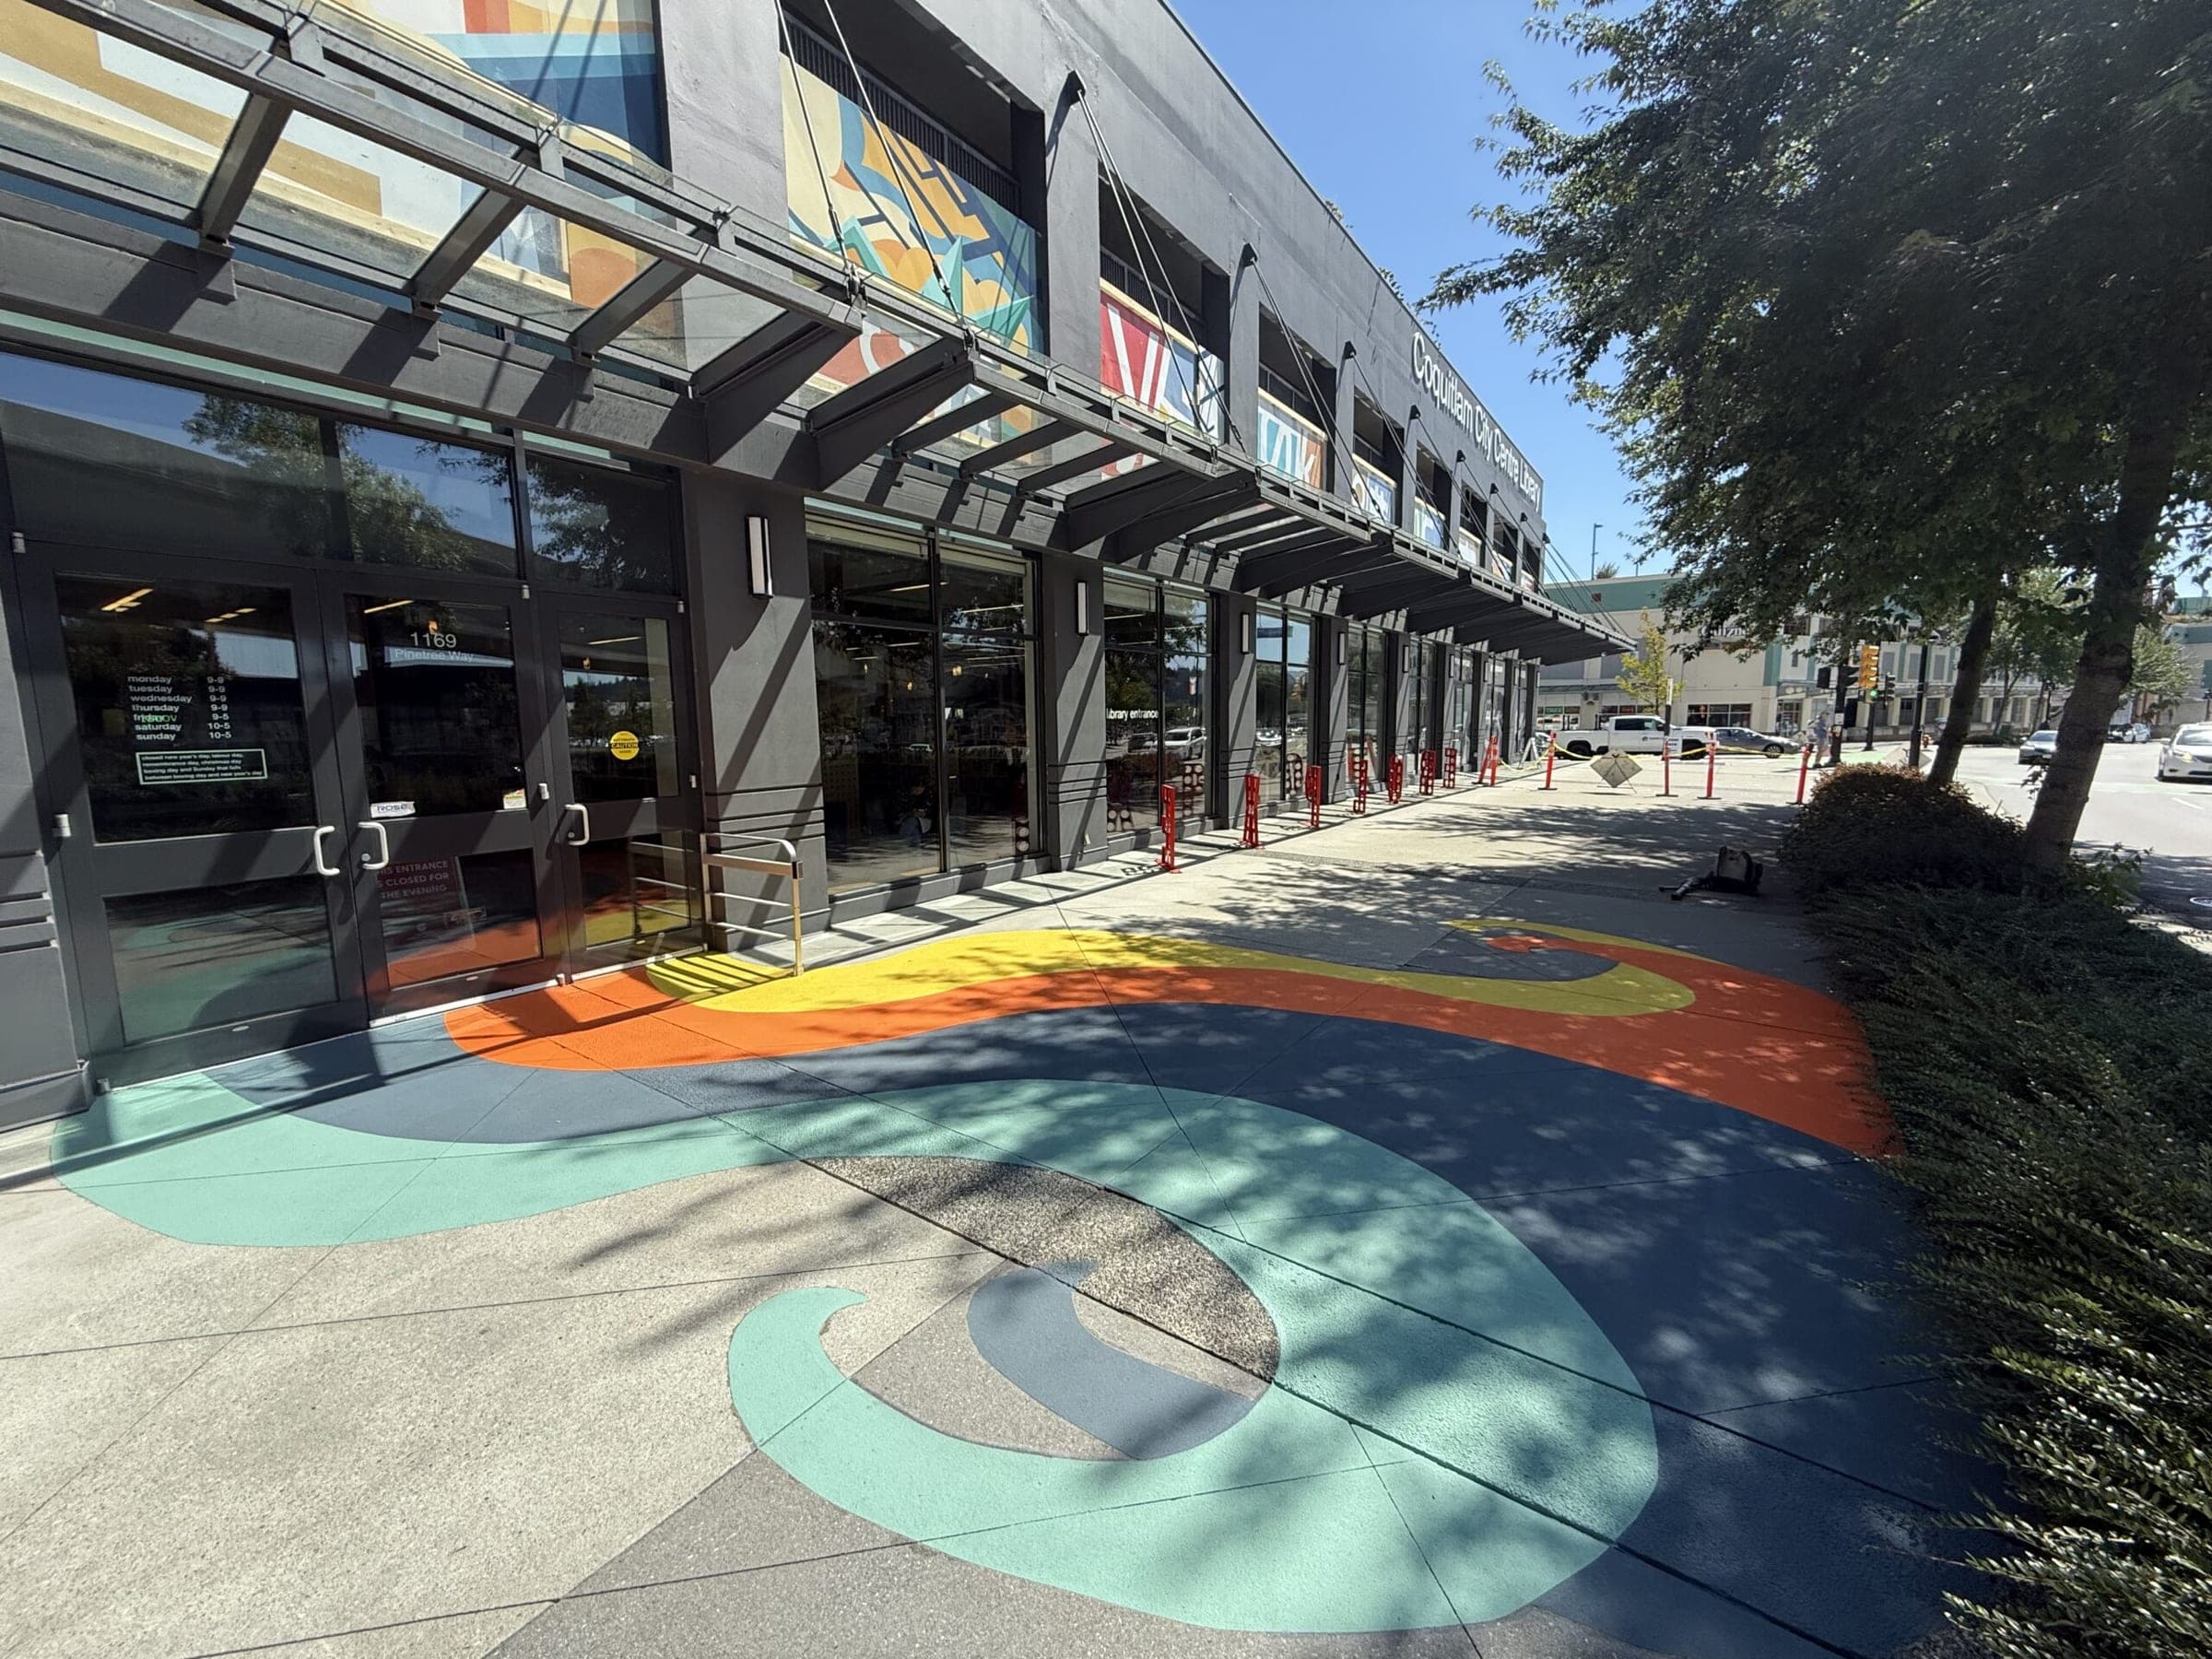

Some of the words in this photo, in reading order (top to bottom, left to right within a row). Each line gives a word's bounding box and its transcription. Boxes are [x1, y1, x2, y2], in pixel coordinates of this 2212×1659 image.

[1414, 332, 1473, 434] Coquitlam
[1475, 405, 1493, 461] City
[1493, 428, 1521, 484] Centre
[1520, 461, 1541, 512] Library
[410, 632, 457, 648] 1169
[395, 649, 446, 660] Pinetree
[449, 651, 475, 663] Way
[127, 676, 172, 684] monday
[128, 685, 172, 693] tuesday
[130, 694, 192, 703] wednesday
[132, 704, 179, 712] thursday
[1106, 707, 1128, 722] library
[1130, 708, 1159, 719] entrance
[135, 723, 182, 732] saturday
[207, 722, 230, 730] 10-5
[136, 733, 176, 741] sunday
[396, 861, 448, 873] ENTRANCE
[385, 875, 427, 887] CLOSED
[429, 872, 449, 881] FOR
[380, 890, 400, 899] THE
[403, 884, 448, 897] EVENING
